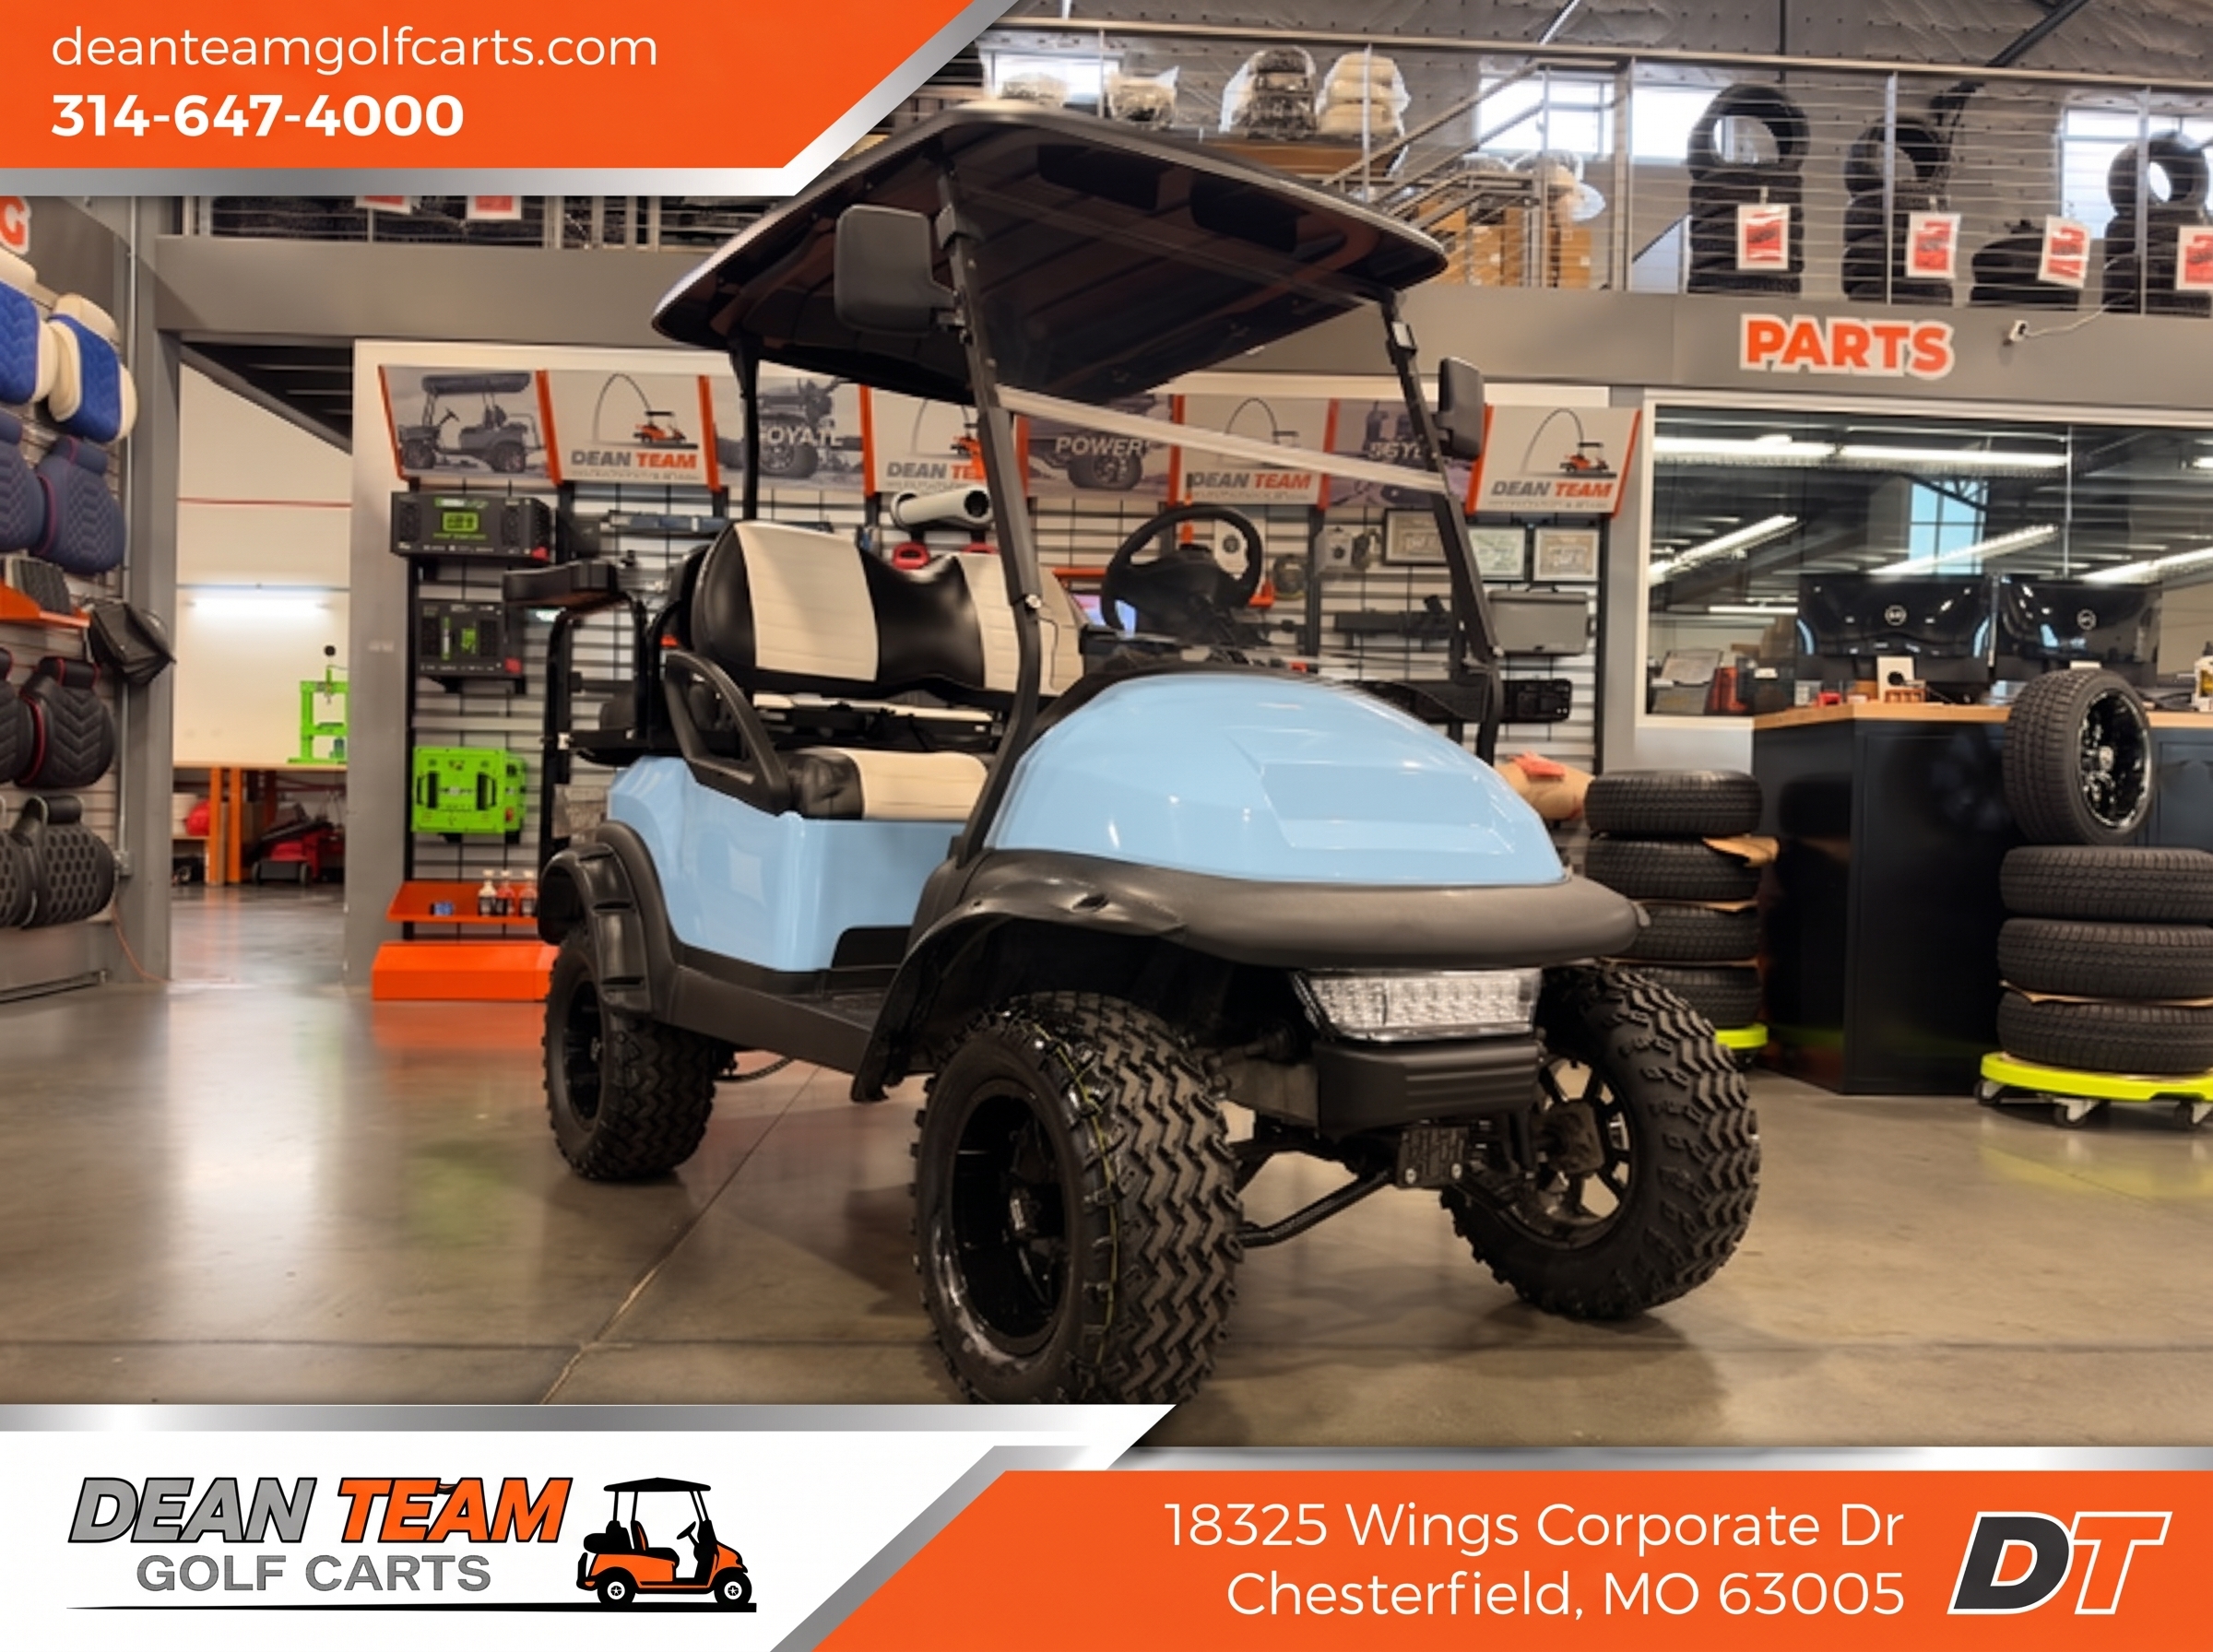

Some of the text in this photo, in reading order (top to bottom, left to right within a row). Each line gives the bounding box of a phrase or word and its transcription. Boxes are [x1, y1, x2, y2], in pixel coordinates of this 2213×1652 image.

[1745, 318, 1949, 374] PARTS
[571, 450, 698, 469] DEAN TEAM
[886, 462, 948, 478] DEAN
[1189, 472, 1312, 490] DEAN TEAM
[1491, 480, 1614, 498] DEAN TEAM
